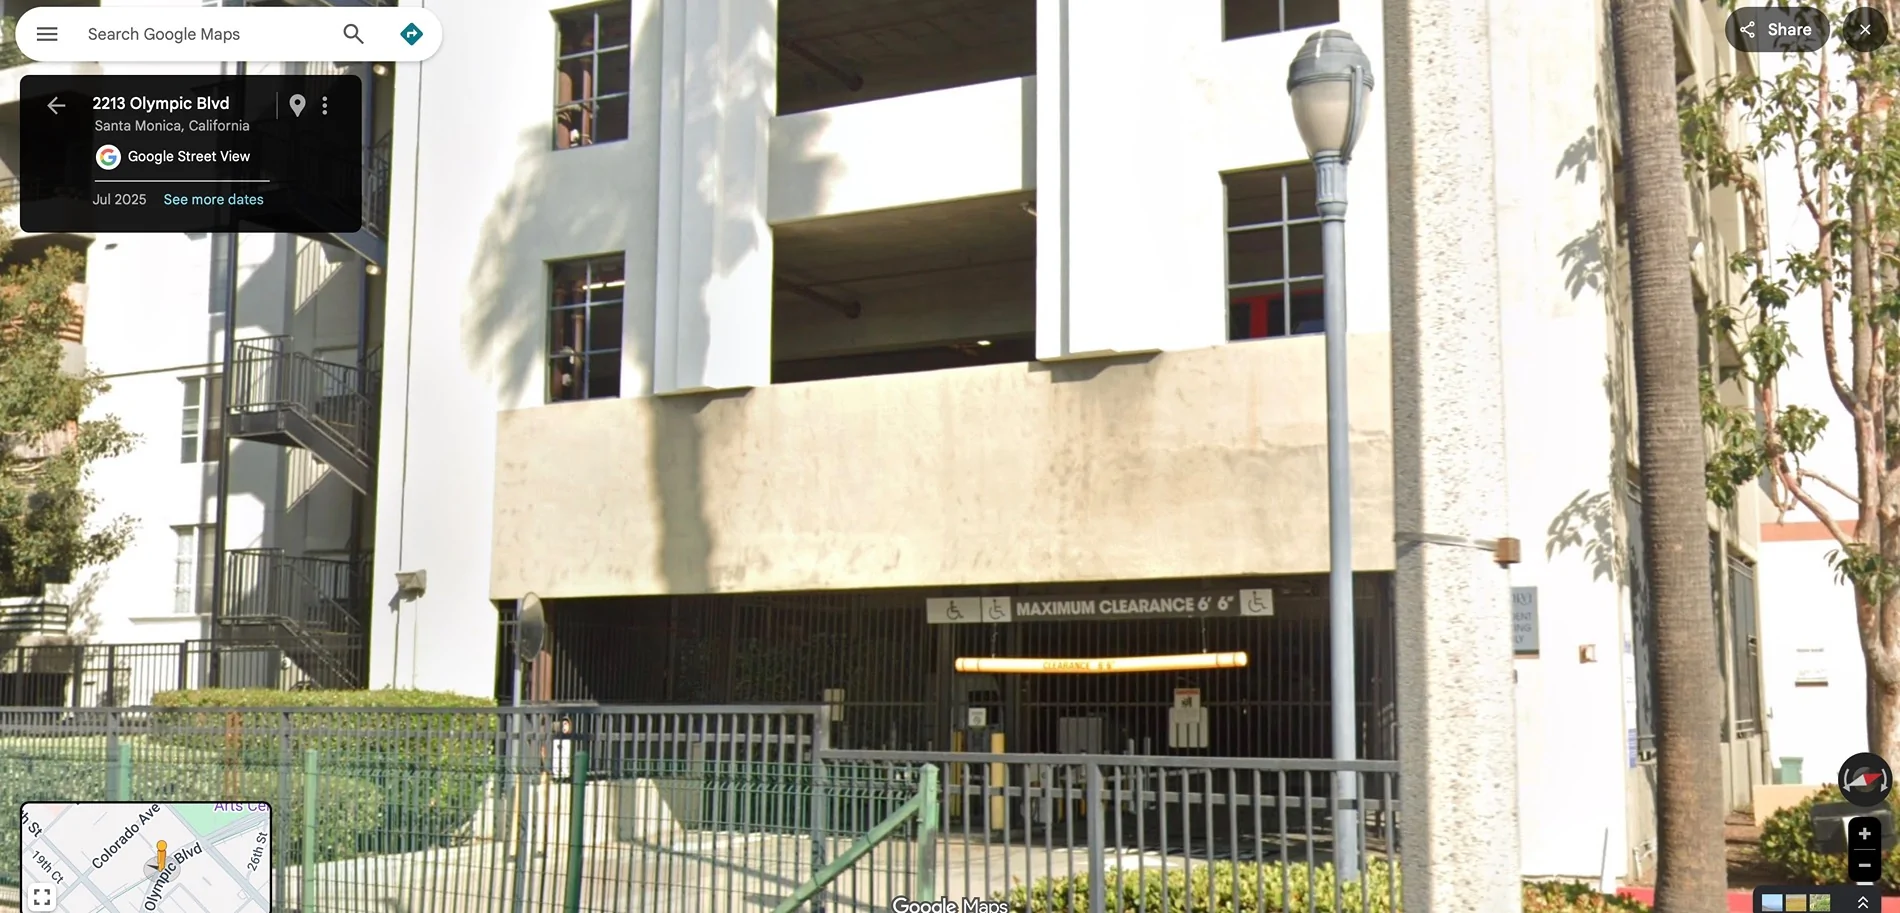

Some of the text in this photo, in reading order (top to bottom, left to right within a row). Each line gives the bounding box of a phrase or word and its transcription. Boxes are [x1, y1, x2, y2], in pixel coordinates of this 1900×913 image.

[1016, 600, 1095, 616] MAXIMUM
[1100, 597, 1194, 614] CLEARANCE
[1043, 661, 1090, 670] CLEARANCE
